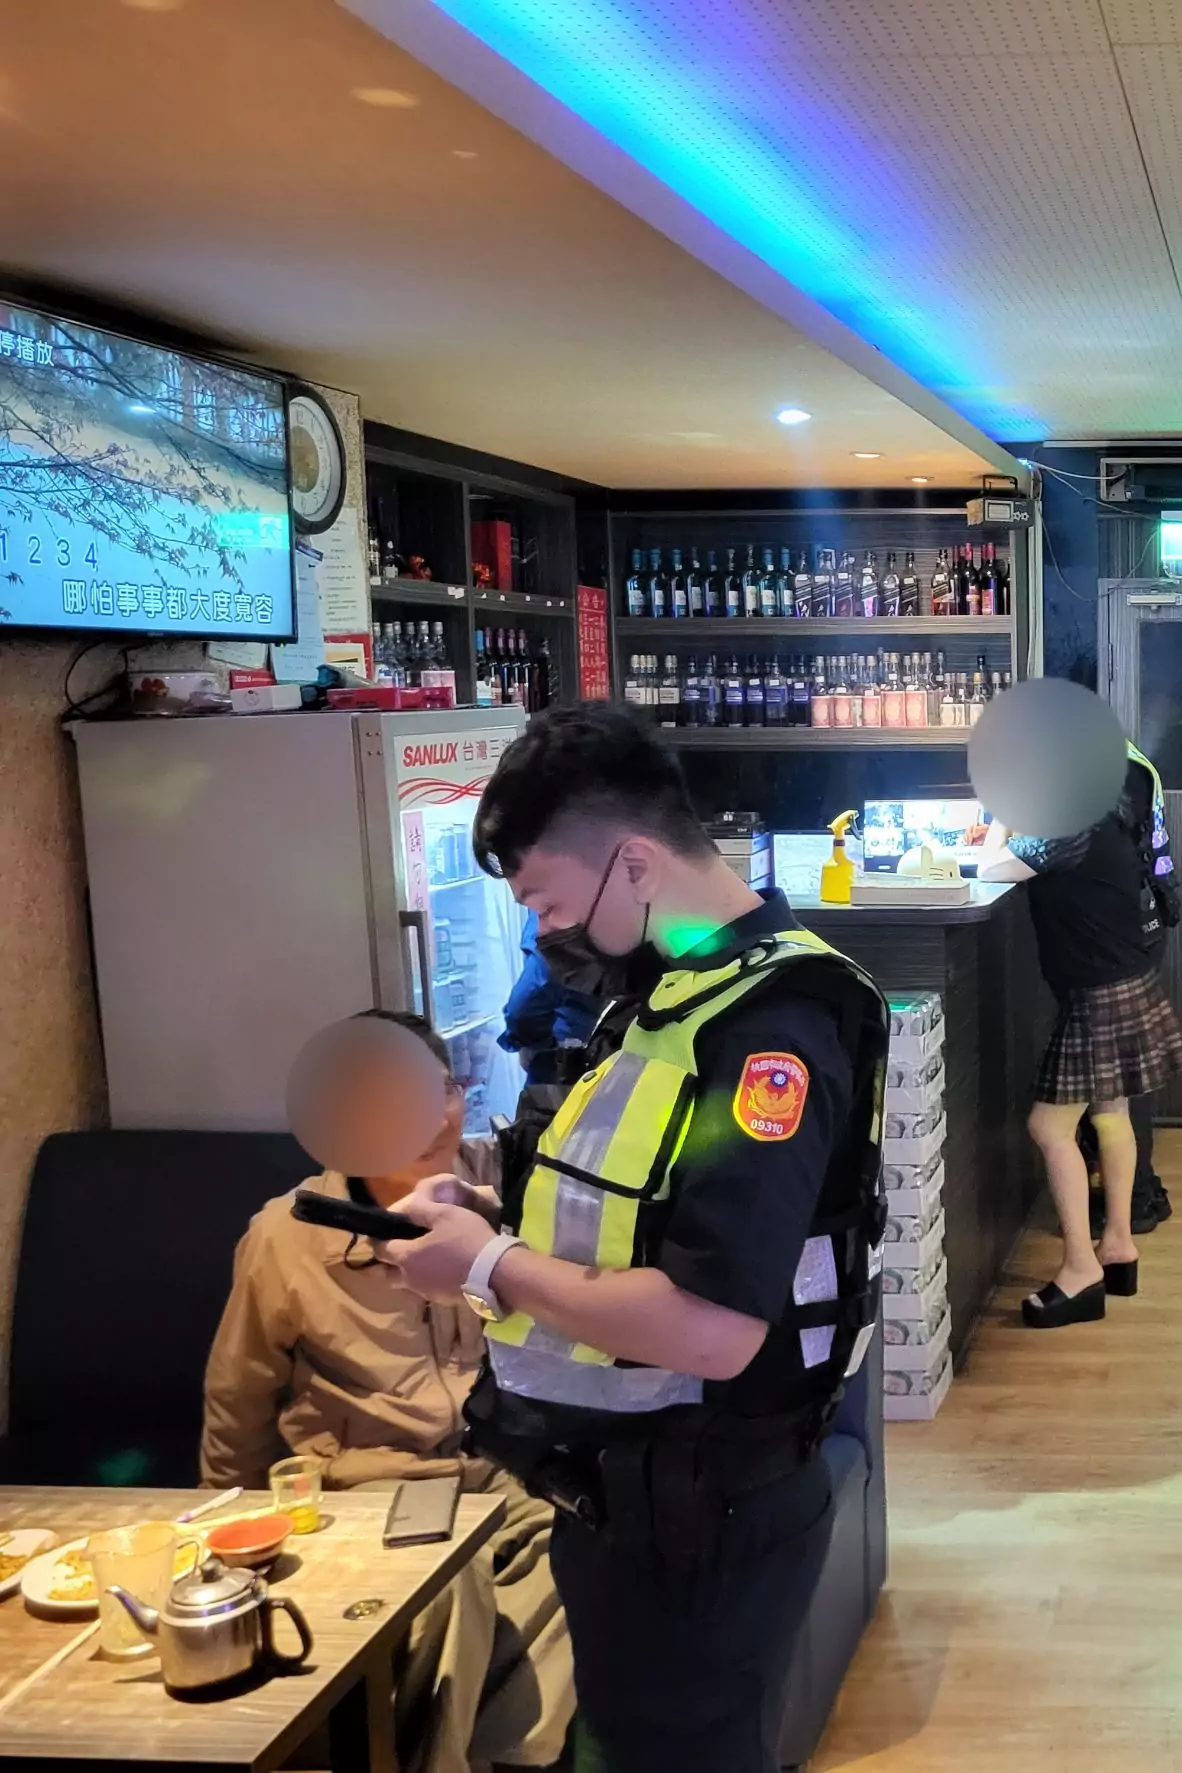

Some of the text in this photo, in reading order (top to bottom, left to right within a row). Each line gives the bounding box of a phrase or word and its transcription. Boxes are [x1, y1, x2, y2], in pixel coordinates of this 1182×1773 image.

[28, 535, 42, 564] 2
[57, 539, 71, 566] 3
[84, 542, 98, 569] 4
[62, 578, 274, 624] 哪怕事事都大度寬容
[403, 742, 459, 768] SANLUX
[750, 1119, 783, 1134] 09310
